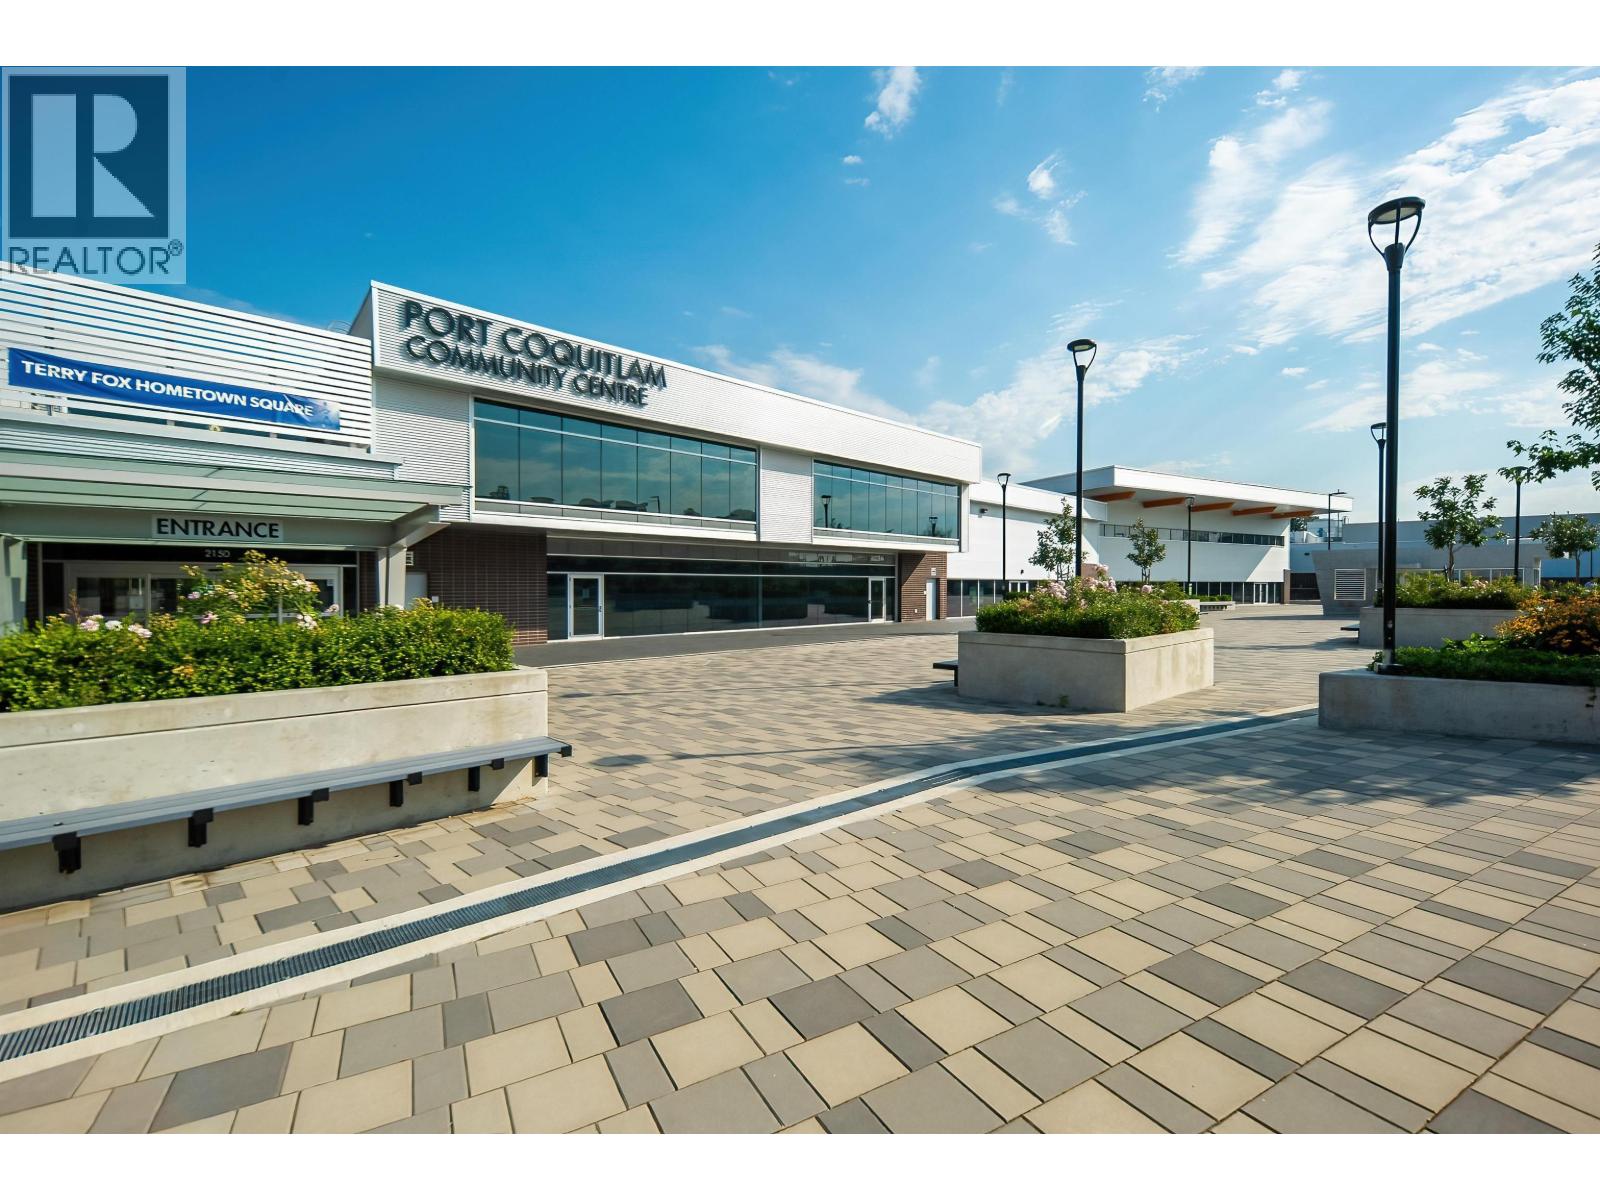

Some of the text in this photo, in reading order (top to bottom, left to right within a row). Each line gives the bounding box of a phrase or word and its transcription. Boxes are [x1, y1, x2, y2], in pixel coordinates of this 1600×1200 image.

[404, 299, 667, 389] PORT COQUITLAM
[405, 335, 648, 406] COMMUNITY CENTRE
[21, 360, 314, 417] TERRY FOX HOMETOWN SQUARE
[156, 518, 280, 538] ENTRANCE
